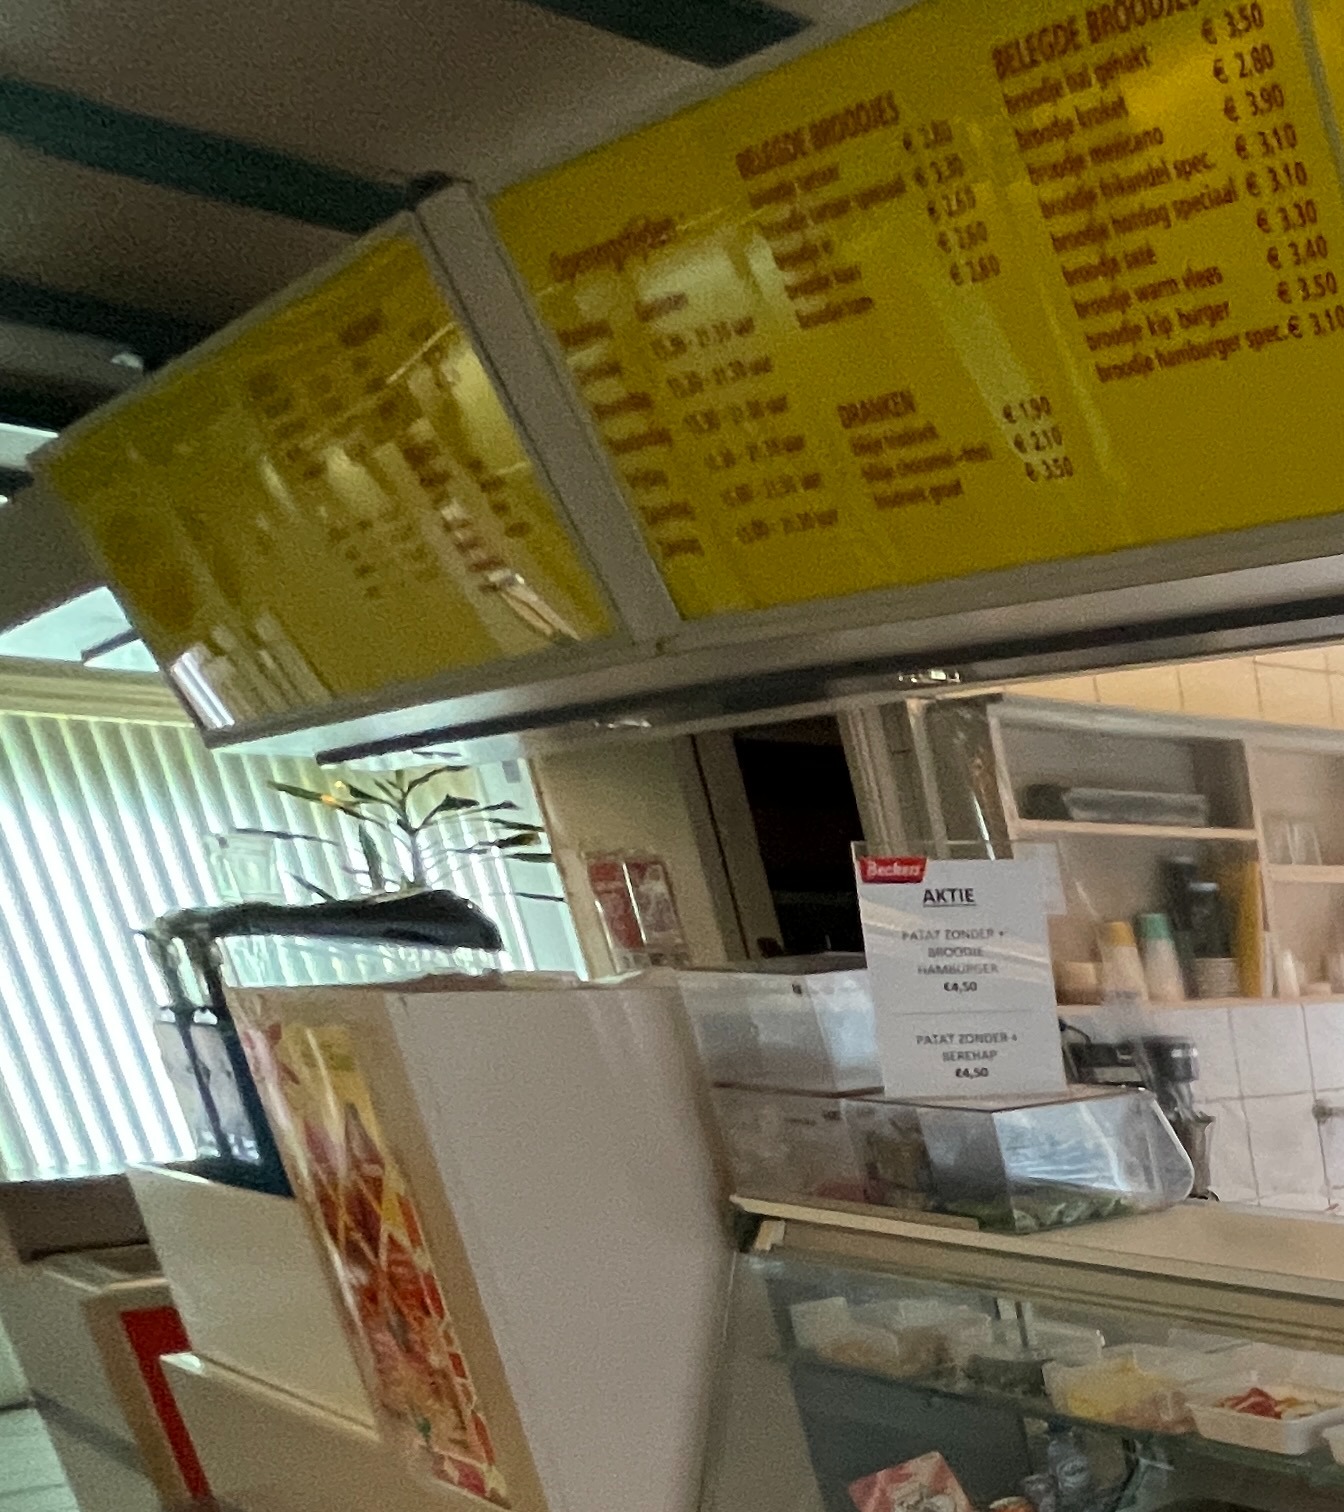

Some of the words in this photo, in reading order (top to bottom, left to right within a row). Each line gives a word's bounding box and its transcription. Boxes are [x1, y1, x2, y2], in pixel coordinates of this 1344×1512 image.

[923, 888, 975, 903] AKTIE
[943, 982, 978, 994] €4,50
[955, 1067, 989, 1078] €4,50
